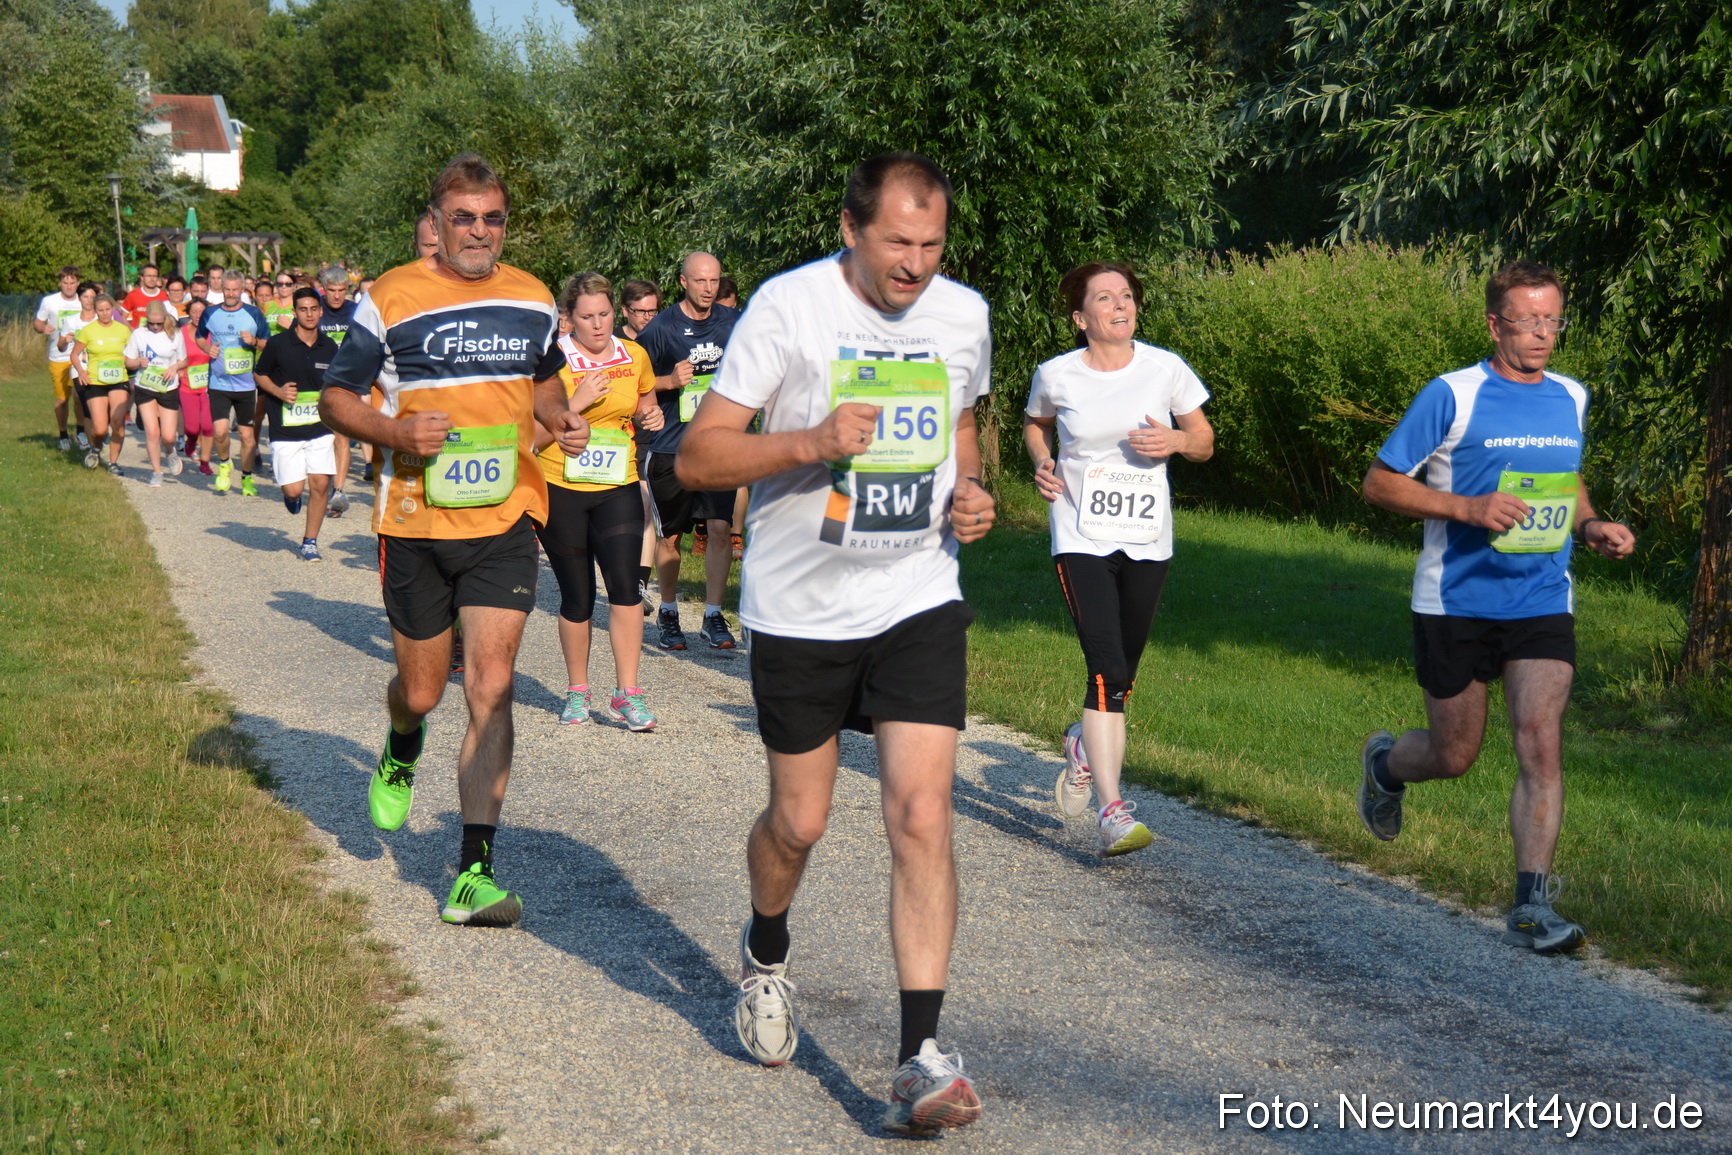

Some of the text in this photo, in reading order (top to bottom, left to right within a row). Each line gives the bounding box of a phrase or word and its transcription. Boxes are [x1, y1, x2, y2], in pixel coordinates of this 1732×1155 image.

[444, 333, 530, 355] Fischer
[228, 360, 250, 370] 6099
[454, 353, 527, 364] AUTOMOBILE
[103, 369, 120, 378] 643
[608, 367, 635, 380] BÖGL
[288, 404, 319, 417] 1042
[1484, 435, 1578, 449] energiegeladen
[578, 449, 618, 469] 897
[444, 457, 501, 485] 406
[1088, 466, 1154, 483] df-sports
[865, 483, 918, 516] RW
[1089, 489, 1156, 520] 8912
[1083, 519, 1159, 532] www.df-sports.de
